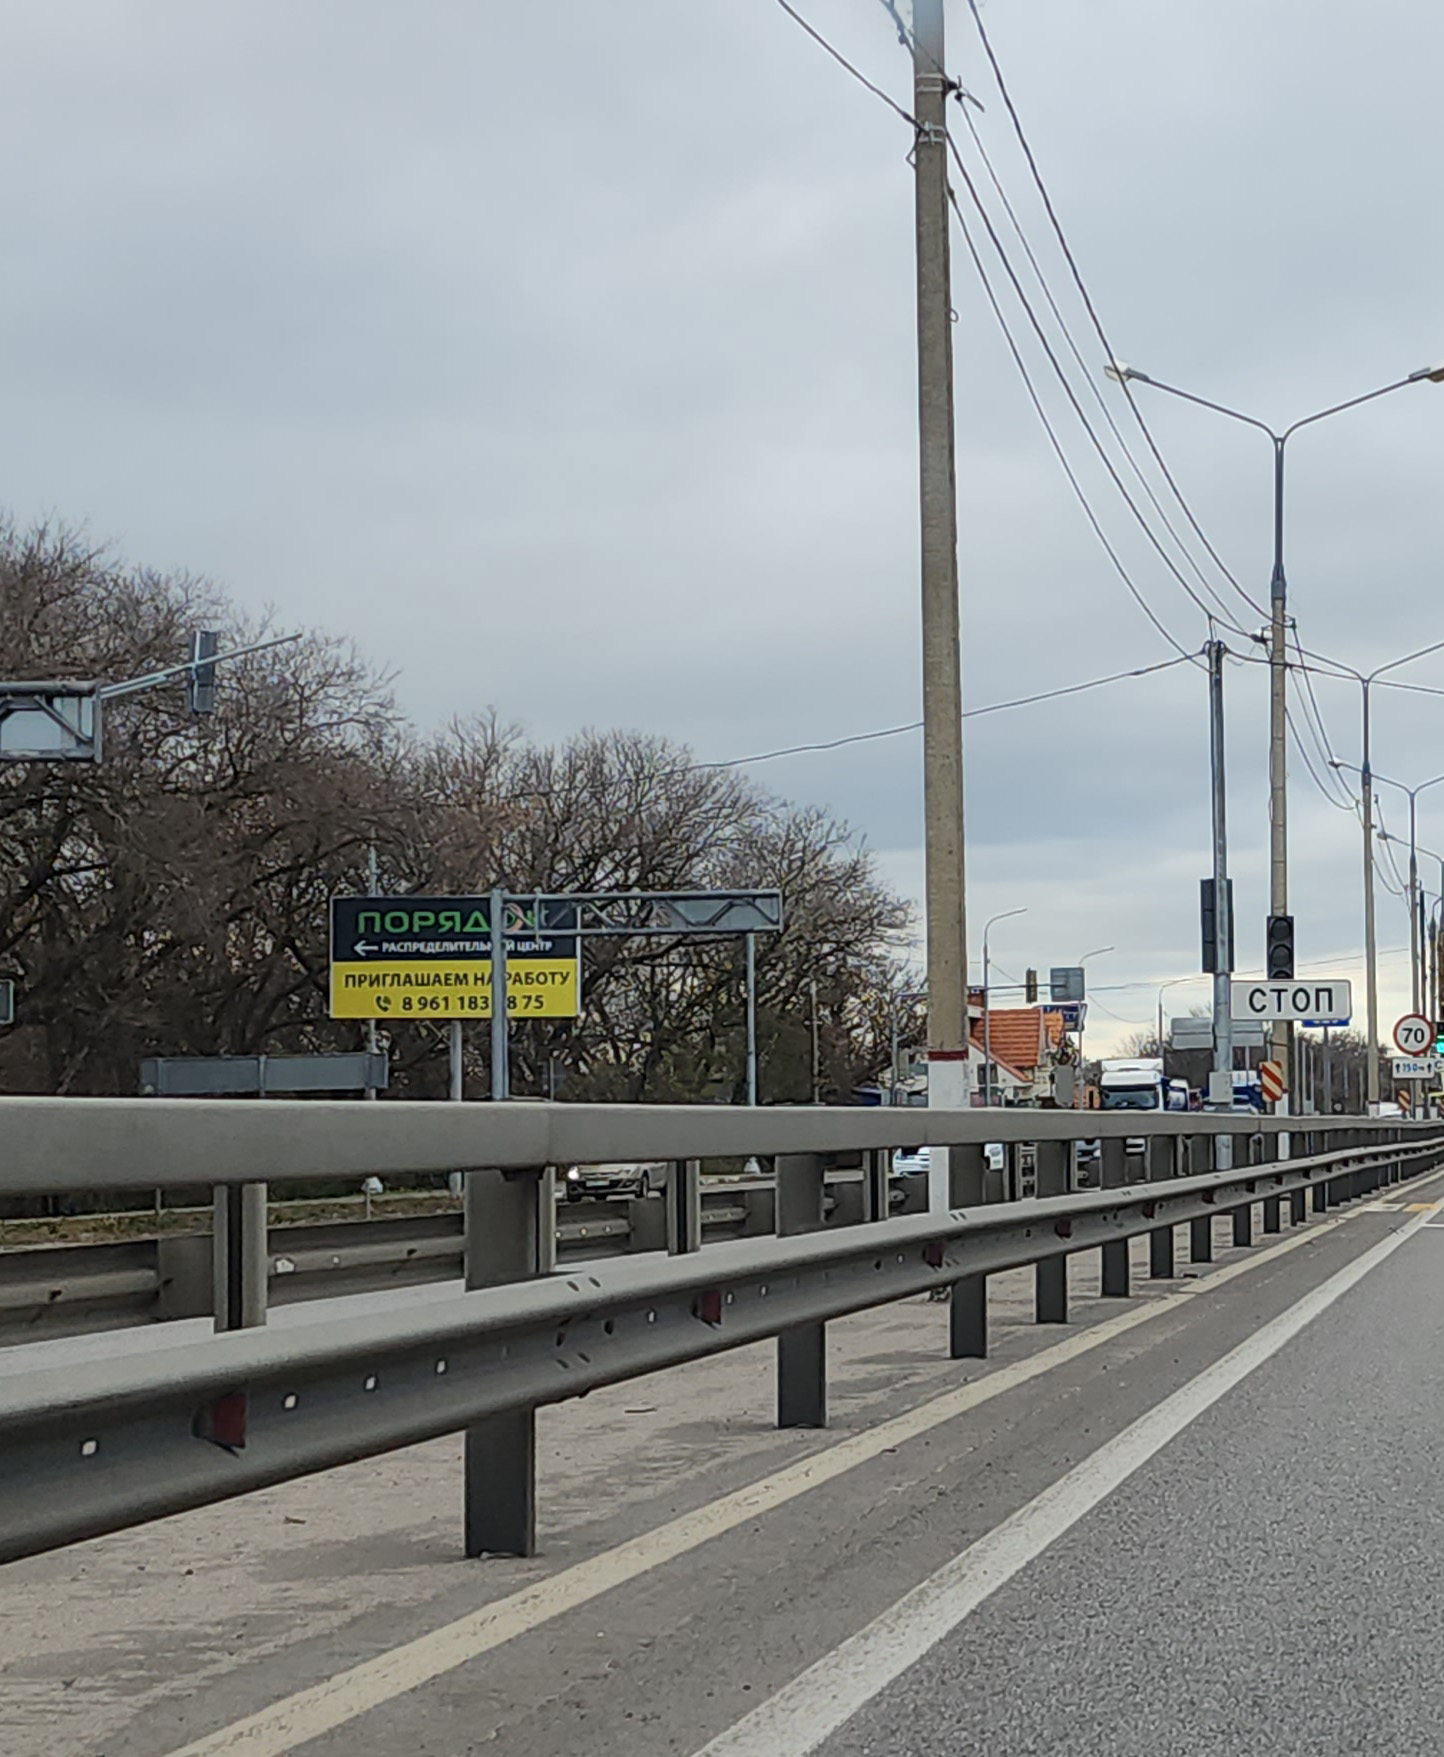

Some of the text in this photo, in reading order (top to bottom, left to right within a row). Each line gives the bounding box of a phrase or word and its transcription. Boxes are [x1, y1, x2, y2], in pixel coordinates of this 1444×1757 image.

[382, 940, 515, 952] РАСПРЕДЕЛИТЕЛЬЙ
[344, 973, 468, 988] ПРИГЛАШАЕМ
[402, 997, 413, 1011] 8
[418, 997, 450, 1011] 961
[459, 996, 490, 1010] 183
[522, 995, 544, 1010] 75
[1249, 988, 1333, 1013] СТОП
[1402, 1027, 1425, 1044] 70
